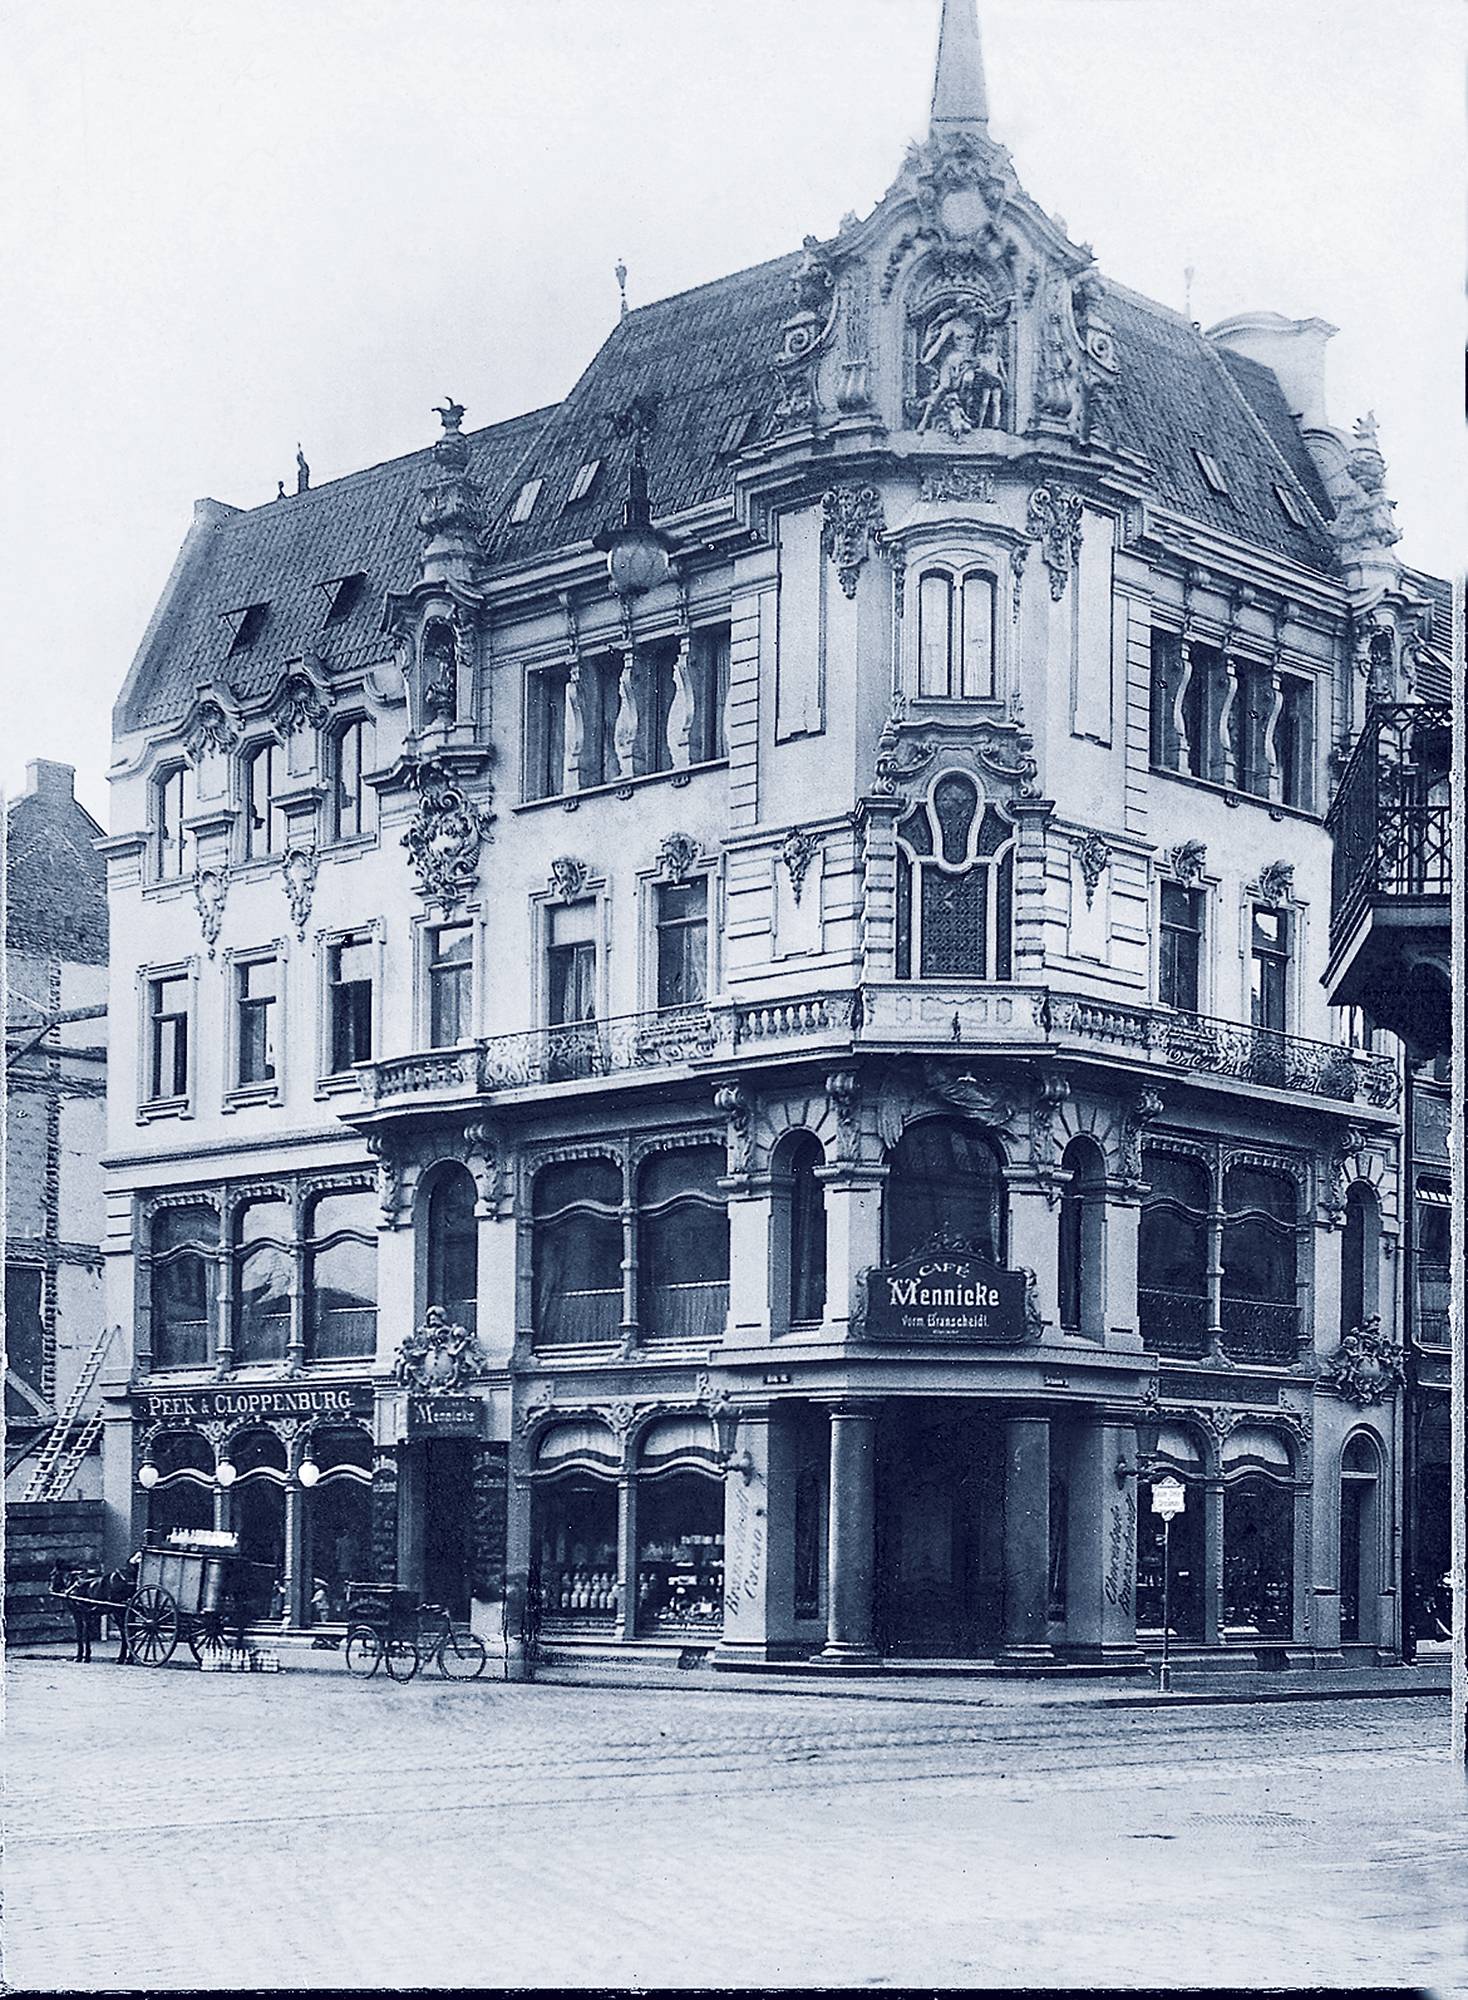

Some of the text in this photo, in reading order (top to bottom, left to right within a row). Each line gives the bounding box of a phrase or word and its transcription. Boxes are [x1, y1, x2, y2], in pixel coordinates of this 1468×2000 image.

[887, 1277, 1000, 1306] Mennicke
[148, 1390, 355, 1416] PEEK & CLOPPENBURG
